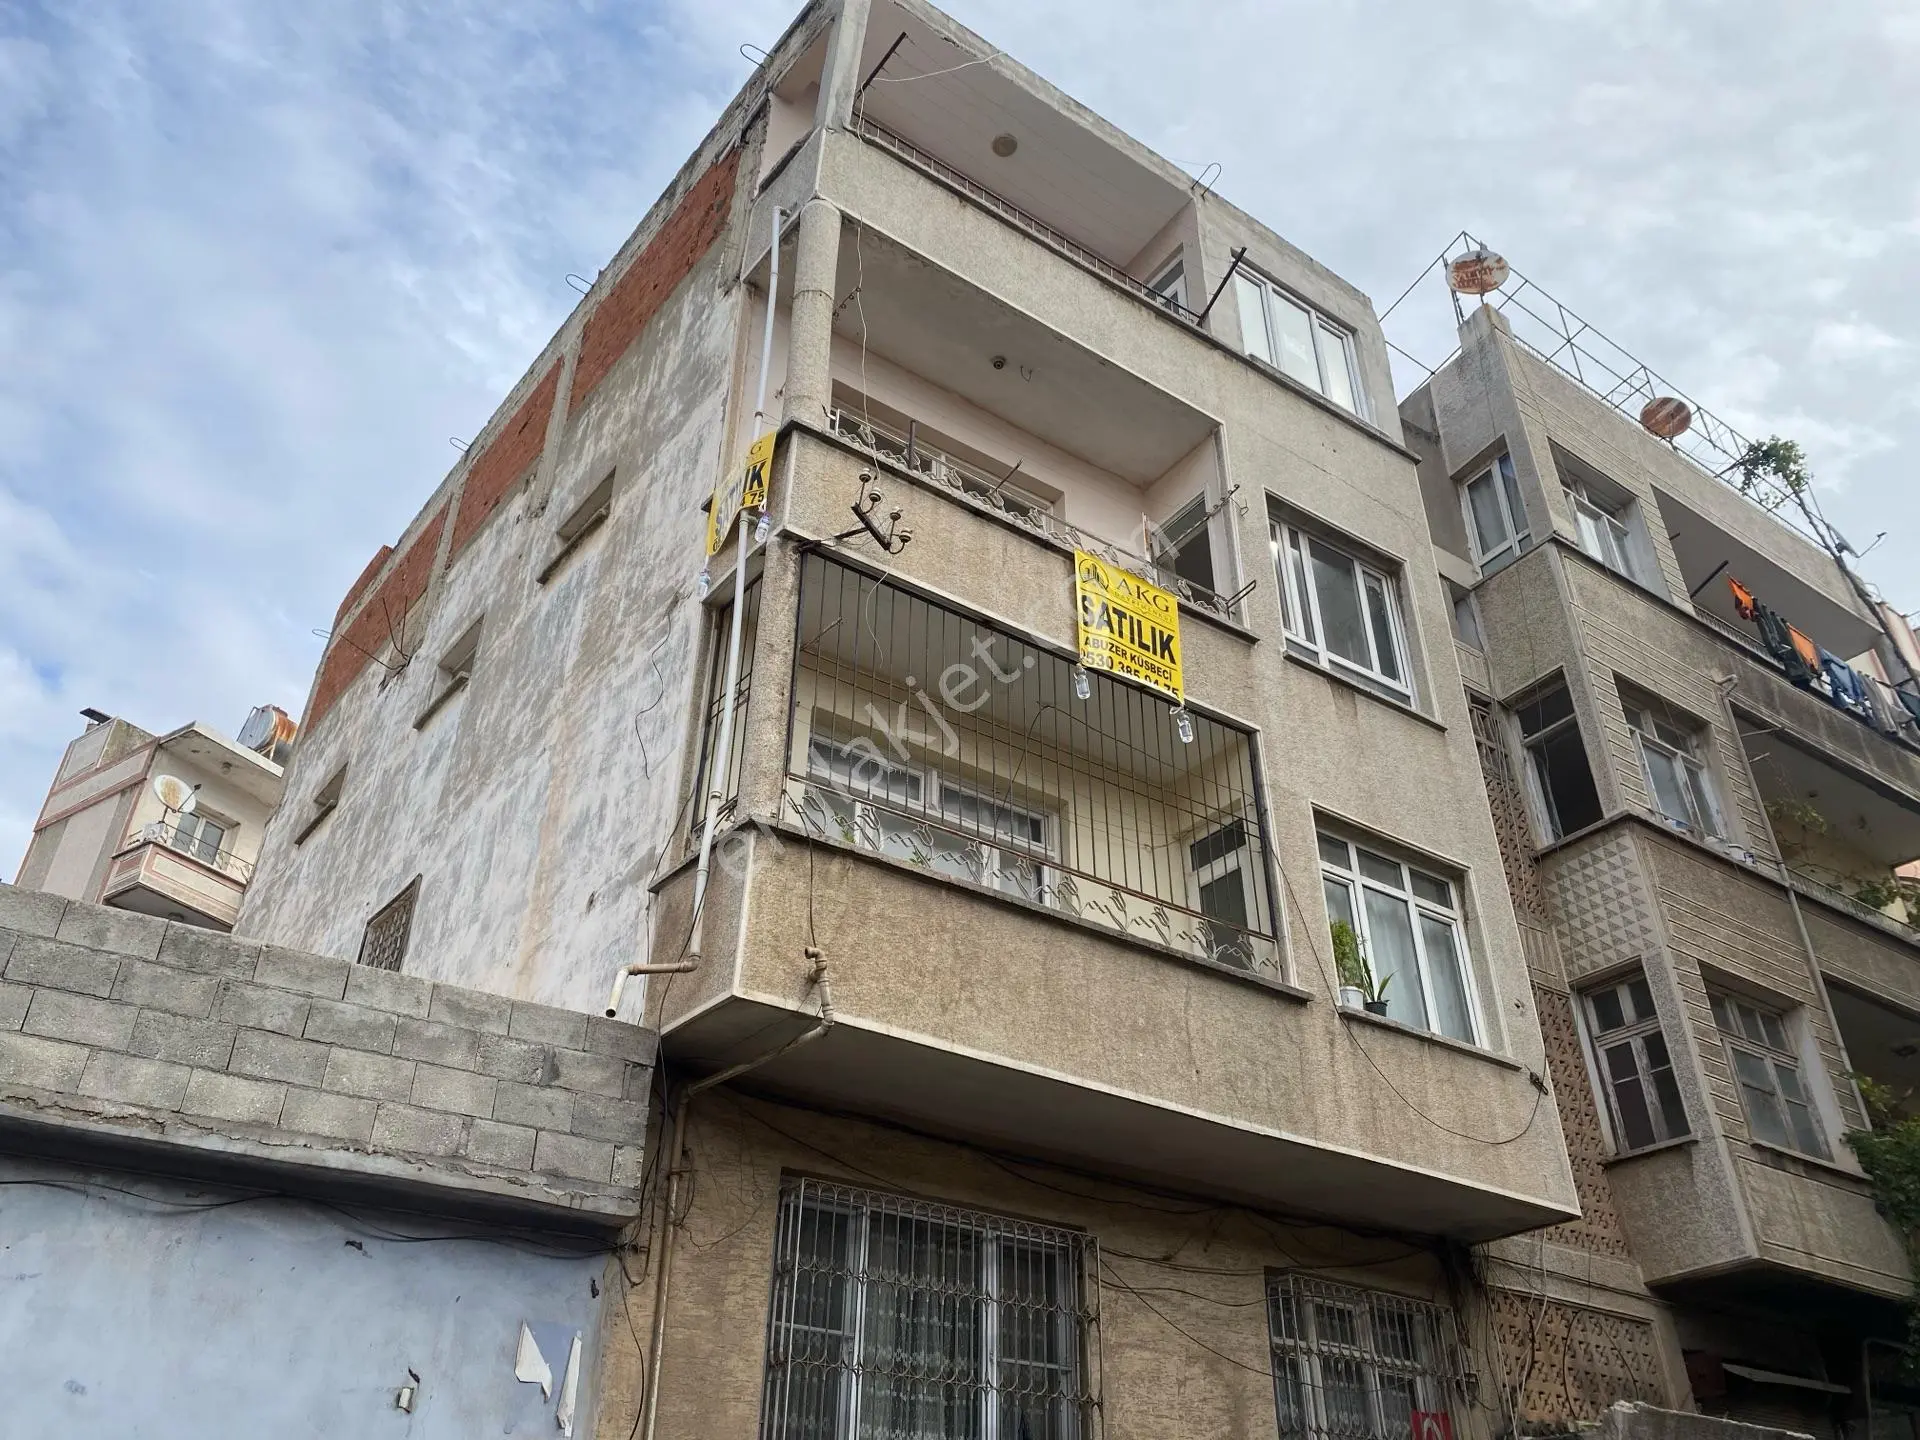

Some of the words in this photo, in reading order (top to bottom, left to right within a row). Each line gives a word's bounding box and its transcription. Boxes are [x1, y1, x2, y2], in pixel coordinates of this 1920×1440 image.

[750, 491, 765, 504] 75
[1117, 578, 1170, 613] AKG
[1081, 594, 1177, 665] SATILIK
[1084, 636, 1128, 660] ABUZER
[1130, 654, 1172, 682] KÜSBECİ
